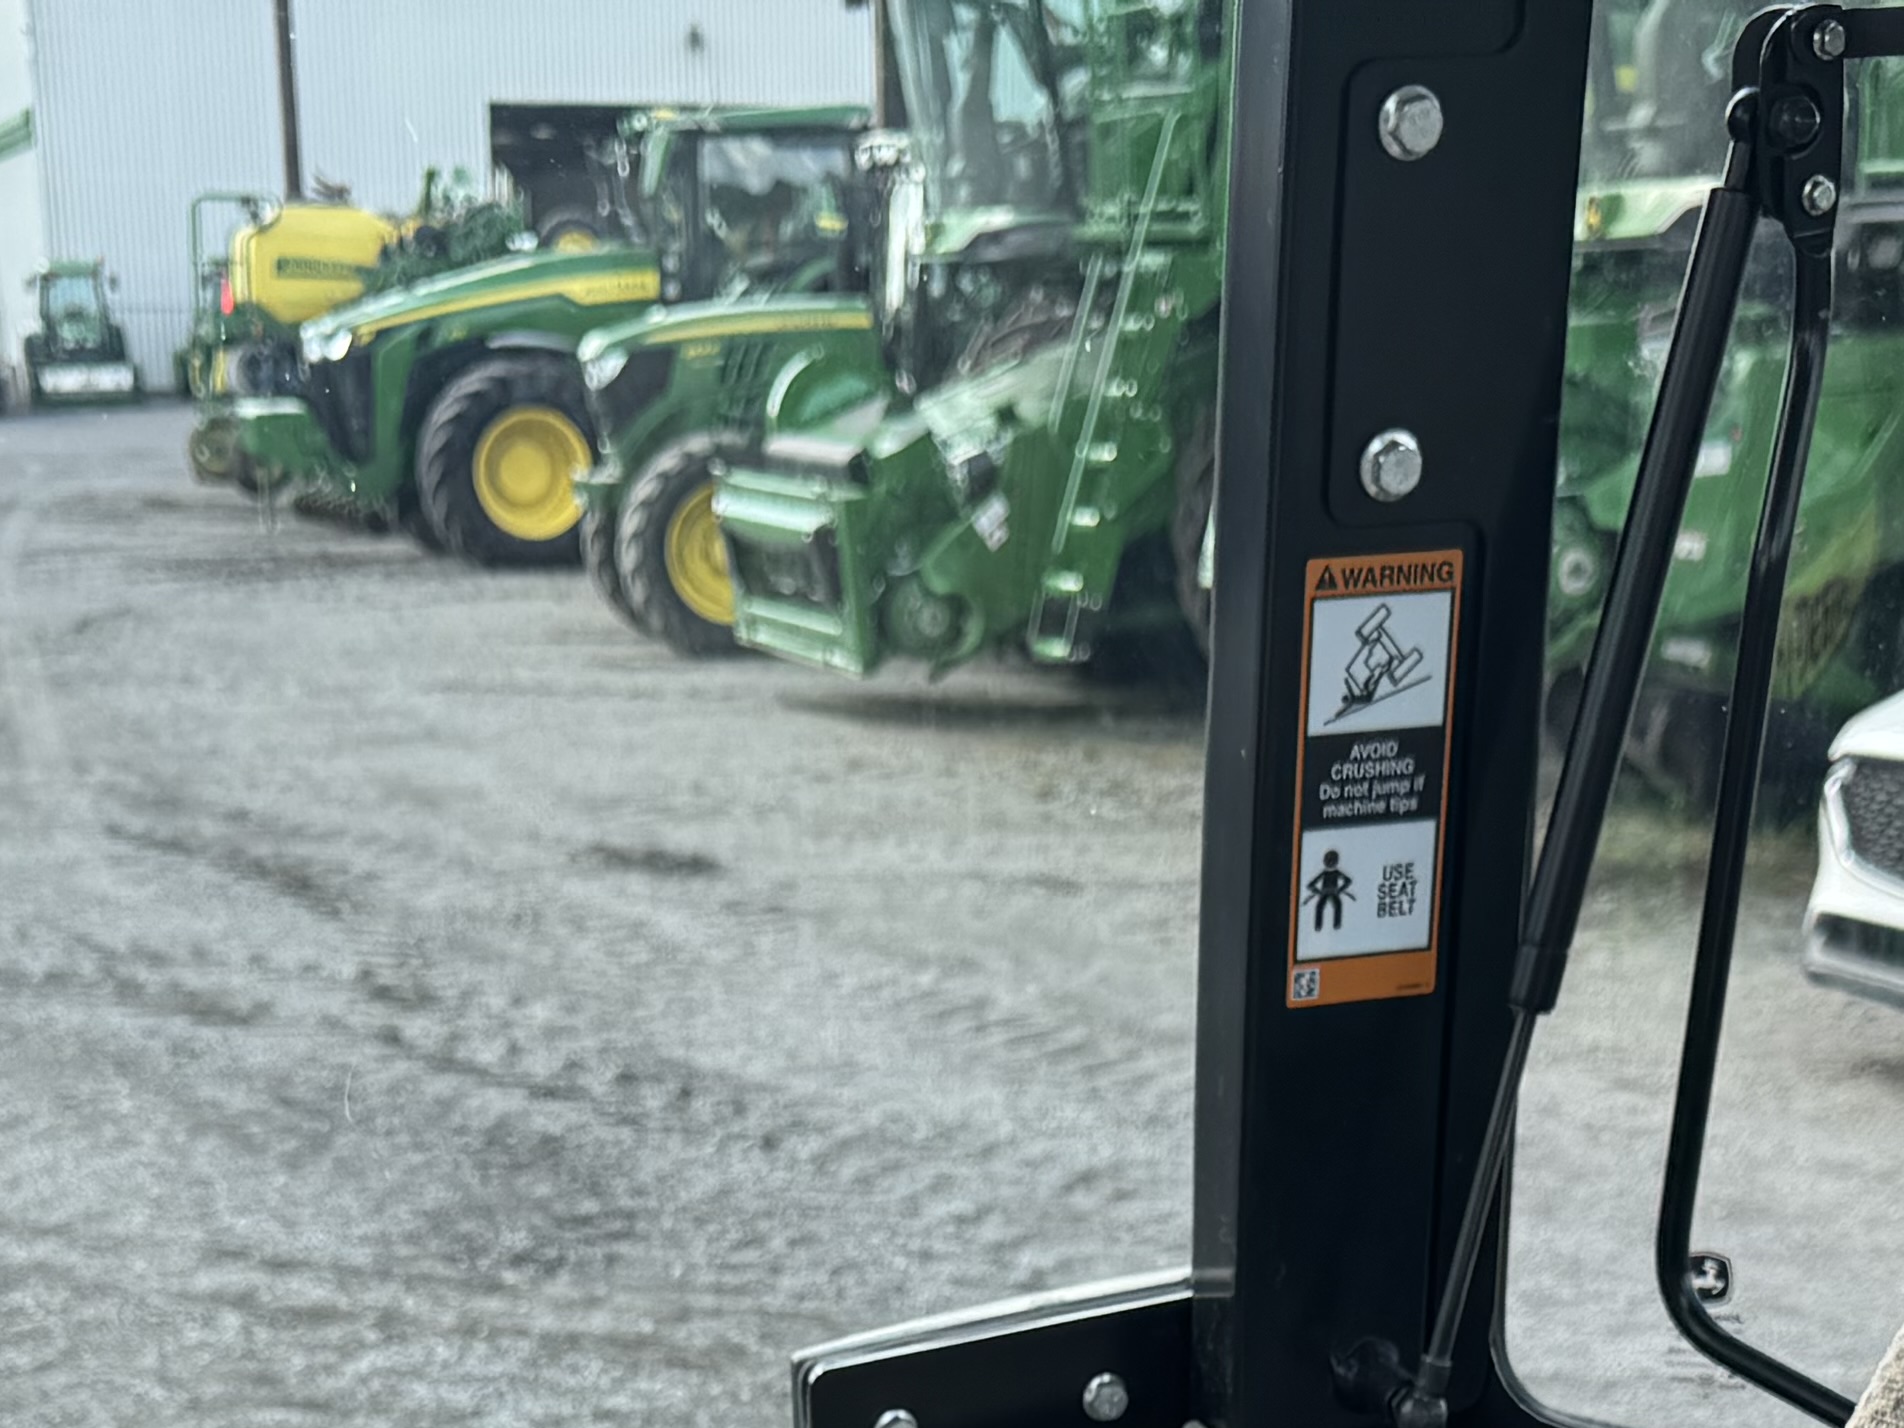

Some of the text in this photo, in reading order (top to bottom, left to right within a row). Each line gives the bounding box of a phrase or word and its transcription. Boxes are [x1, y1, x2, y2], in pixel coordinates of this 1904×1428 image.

[1341, 561, 1454, 590] WARNING
[1350, 741, 1398, 760] AVOID
[1331, 758, 1415, 780] CRUSHING
[1319, 783, 1341, 800] Do
[1344, 780, 1368, 798] not
[1372, 780, 1410, 799] jump
[1323, 800, 1386, 818] machine
[1383, 862, 1414, 881] USE
[1377, 880, 1417, 900] SEAT
[1377, 899, 1415, 918] BELT
